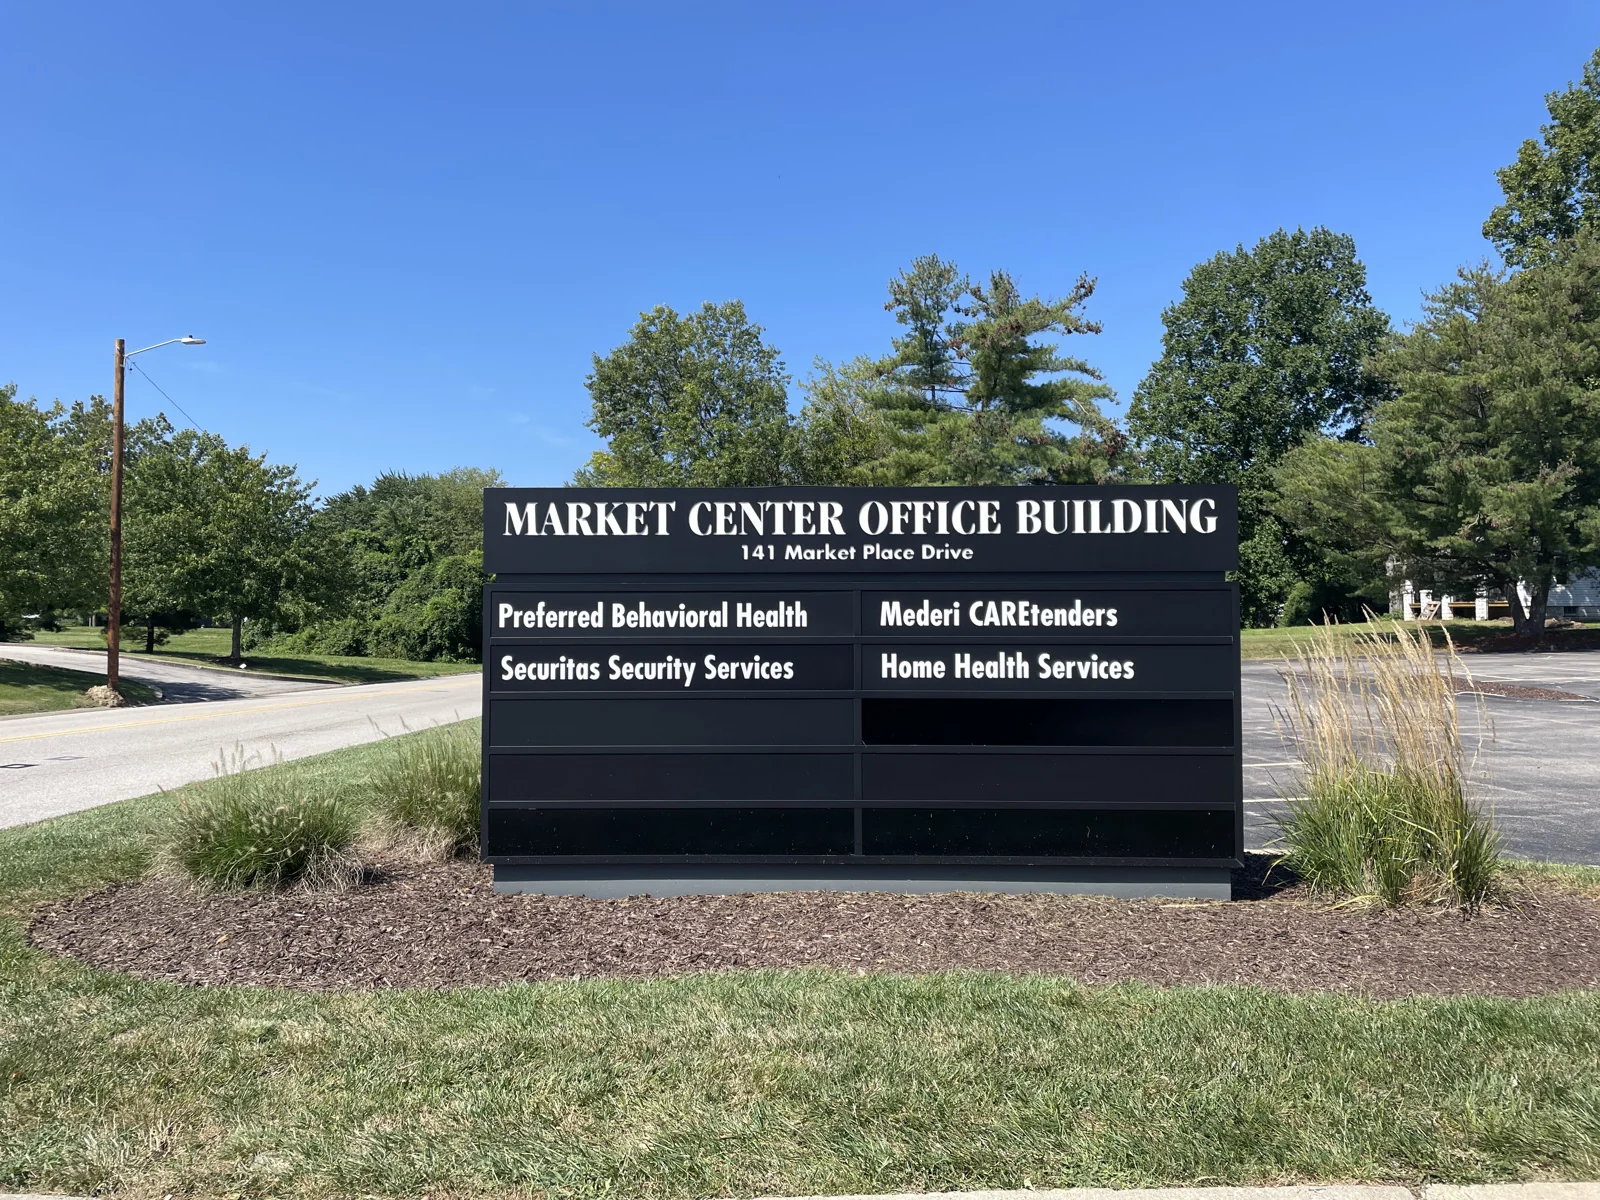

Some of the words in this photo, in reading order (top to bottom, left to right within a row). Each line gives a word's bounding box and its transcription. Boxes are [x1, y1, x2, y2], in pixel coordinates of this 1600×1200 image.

[503, 501, 676, 535] MARKET
[689, 501, 846, 536] CENTER
[859, 500, 1001, 535] OFFICE
[1016, 498, 1218, 534] BUILDING
[742, 545, 774, 560] 141
[785, 543, 856, 560] Market
[863, 543, 914, 559] Place
[922, 543, 973, 559] Drive
[499, 601, 603, 628] Preferred
[612, 601, 728, 628] Behavioral
[737, 601, 807, 627] Health
[880, 600, 960, 626] Mederi
[969, 599, 1117, 626] CAREtenders
[501, 655, 600, 680] Securitas
[609, 655, 696, 687] Security
[704, 654, 793, 679] Services
[882, 653, 945, 678] Home
[955, 652, 1029, 678] Health
[1038, 653, 1134, 679] Services
